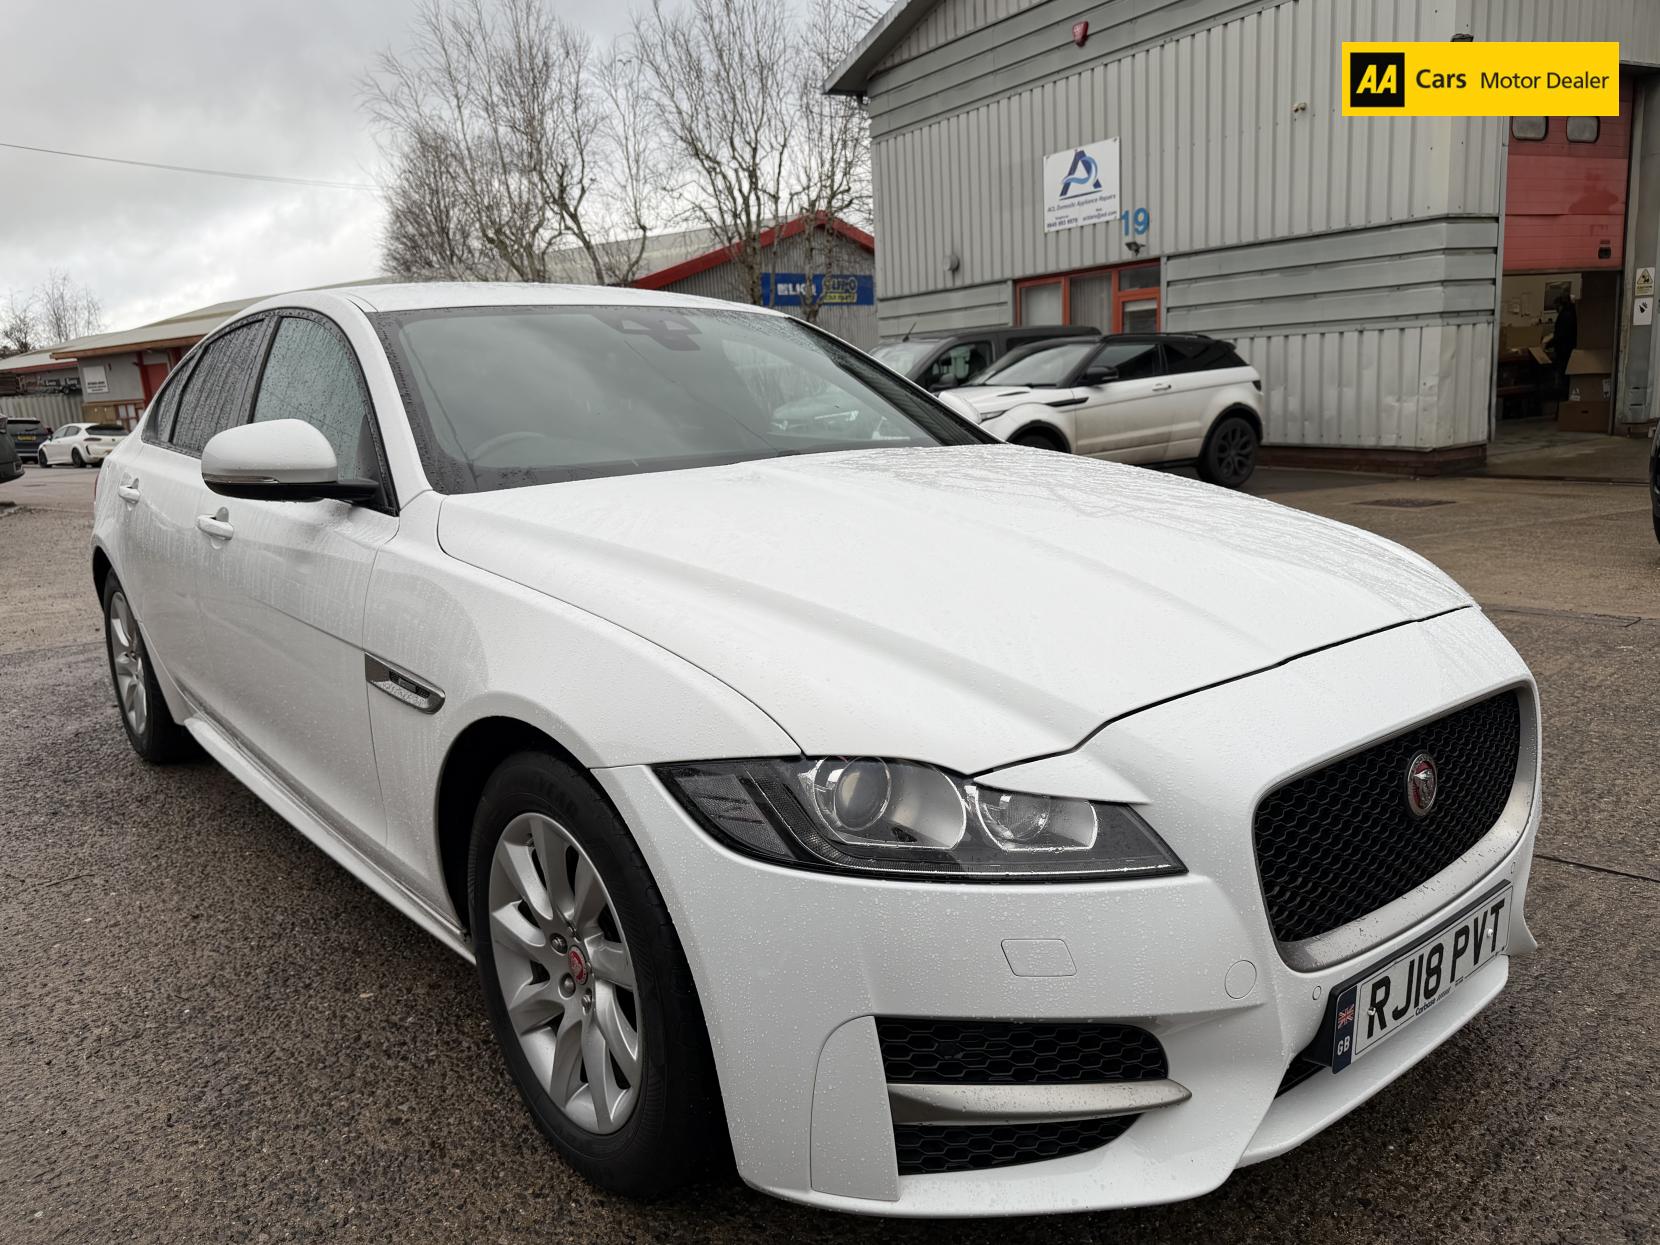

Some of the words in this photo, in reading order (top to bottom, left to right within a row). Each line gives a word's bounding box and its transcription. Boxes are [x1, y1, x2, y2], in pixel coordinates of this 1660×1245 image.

[1120, 207, 1151, 236] 19
[1366, 942, 1444, 1040] RJ18
[1450, 898, 1506, 984] PVT
[1337, 1035, 1350, 1056] GB
